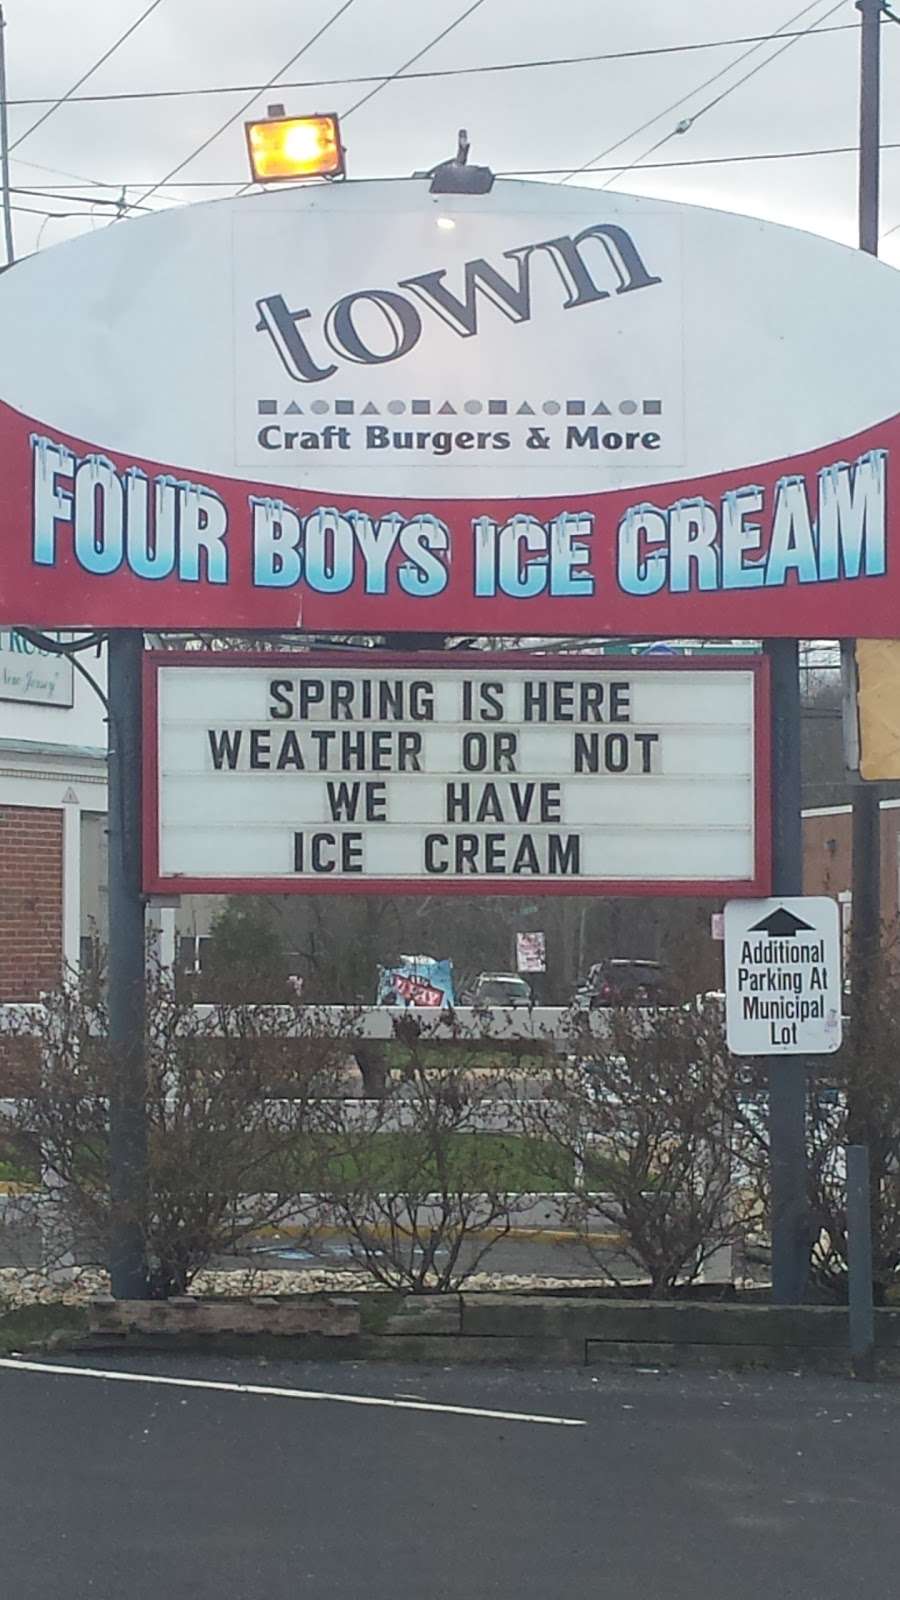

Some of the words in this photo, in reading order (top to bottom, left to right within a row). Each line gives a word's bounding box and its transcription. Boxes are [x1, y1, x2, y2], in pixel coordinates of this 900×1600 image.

[256, 224, 661, 383] town
[258, 426, 350, 449] Craft
[367, 426, 510, 455] Burgers
[527, 428, 549, 449] &
[567, 427, 660, 449] More
[30, 432, 229, 585] FOUR
[248, 494, 450, 598] BOYS
[471, 510, 596, 599] ICE
[615, 447, 889, 597] CREAM
[270, 680, 433, 720] SPRING
[463, 681, 503, 720] IS
[524, 681, 629, 720] HERE
[209, 730, 421, 770] WEATHER
[463, 732, 516, 771] OR
[575, 733, 658, 772] NOT
[327, 782, 386, 821] WE
[447, 783, 560, 821] HAVE
[295, 832, 362, 871] ICE
[425, 834, 579, 872] CREAM
[742, 940, 824, 964] Additional
[739, 968, 802, 993] Parking
[811, 967, 827, 989] At
[744, 995, 824, 1022] Municipal
[771, 1022, 797, 1044] Lot
